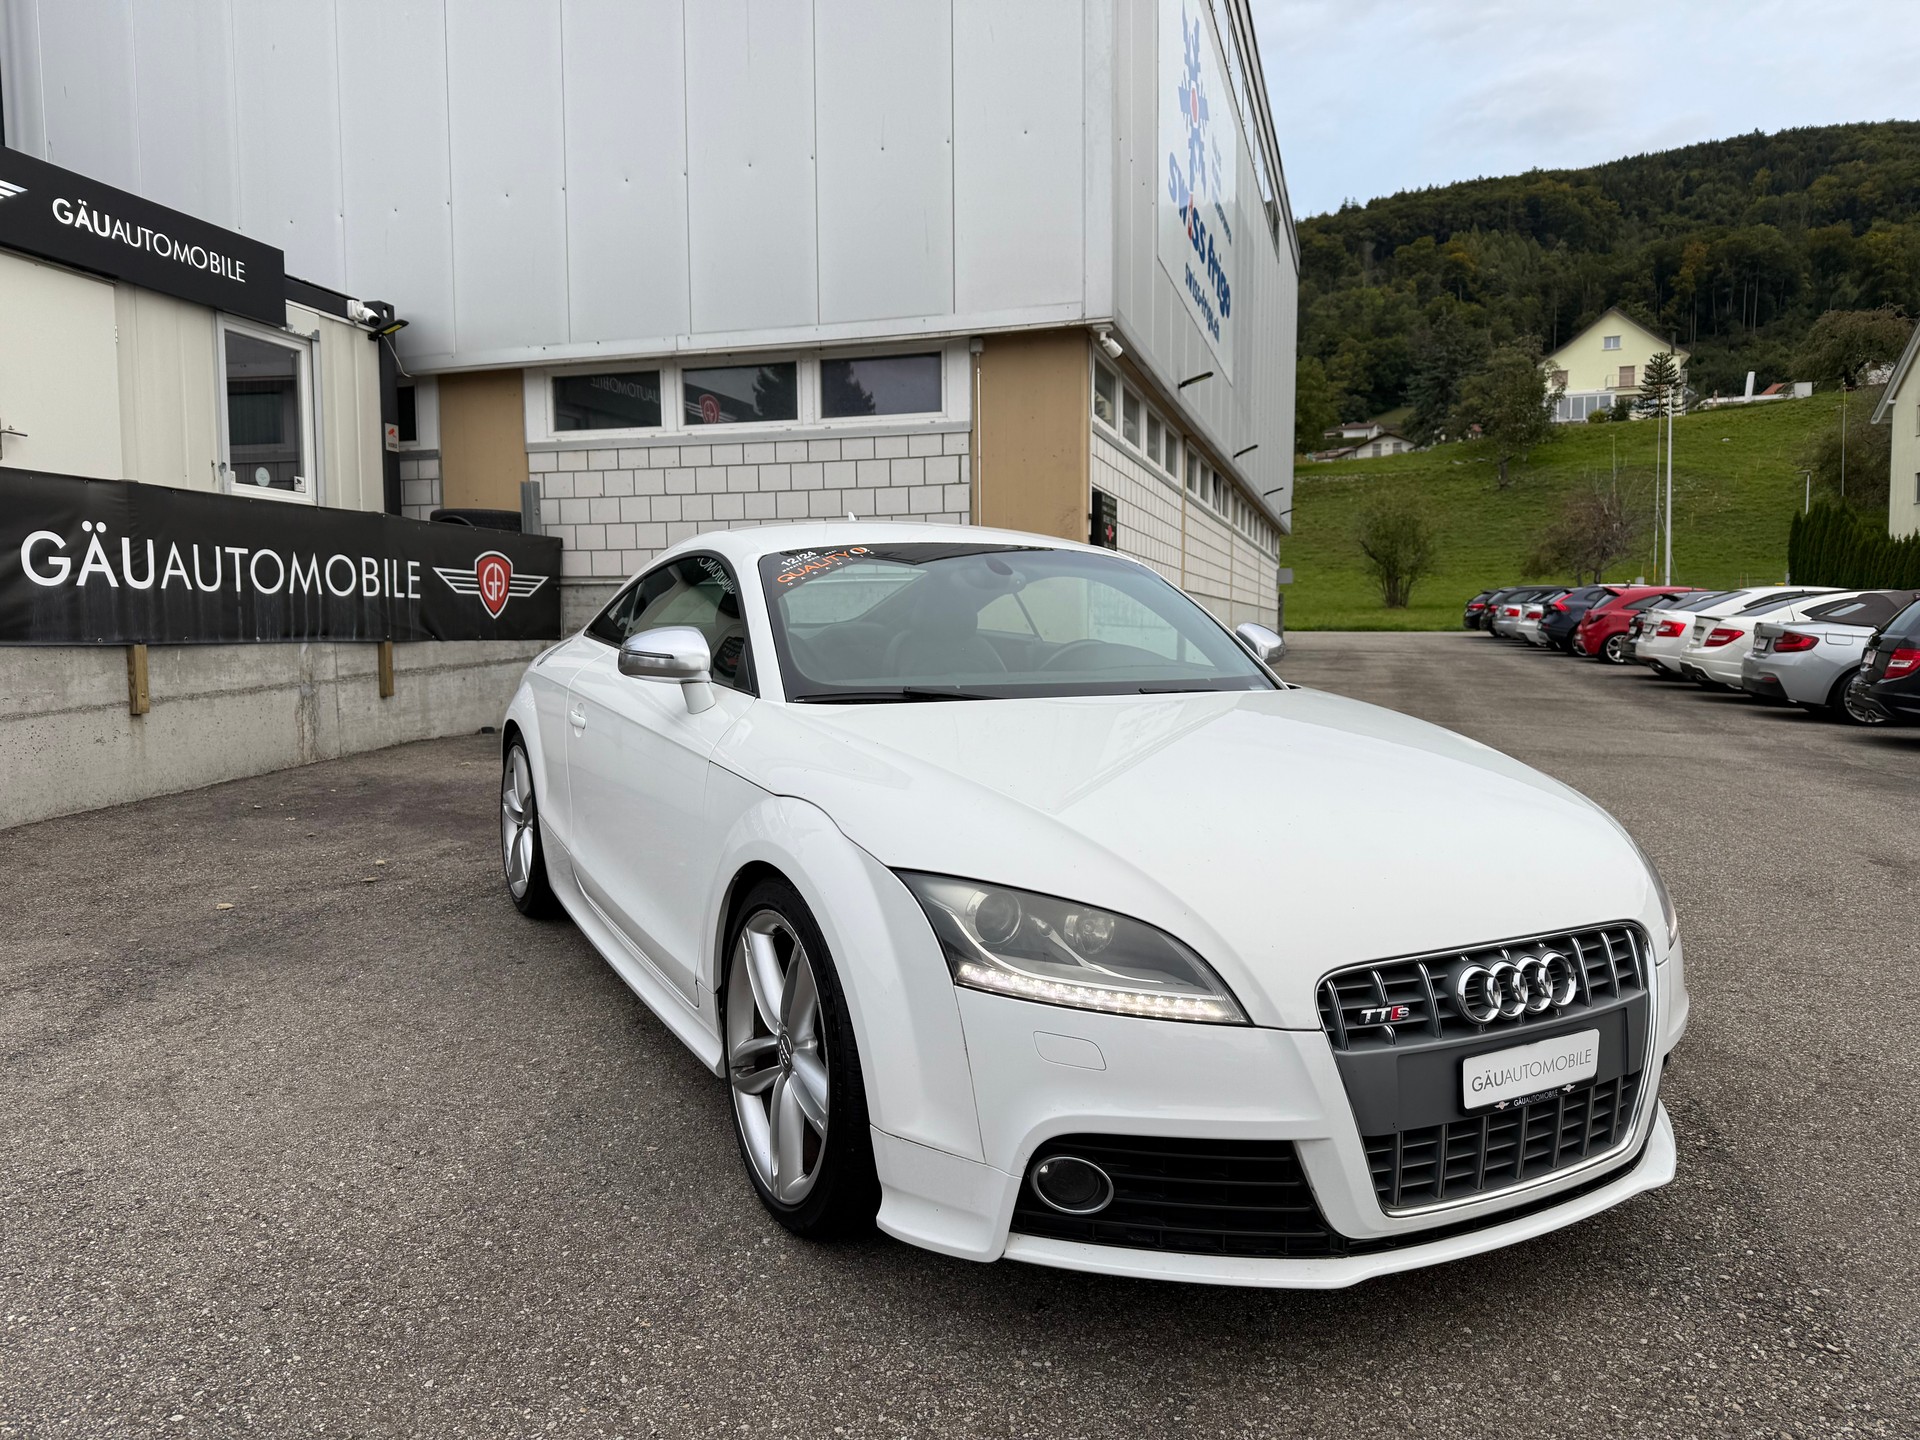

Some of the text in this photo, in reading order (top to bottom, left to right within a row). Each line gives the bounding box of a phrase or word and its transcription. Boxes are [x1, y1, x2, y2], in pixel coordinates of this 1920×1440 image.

[52, 198, 246, 283] GÄUAUTOMOBILE
[20, 520, 421, 599] GÄUAUTOMOBILE
[777, 551, 850, 583] QUALITY
[1361, 1006, 1410, 1024] TTS
[1471, 1048, 1592, 1092] GÄUAUTOMOBILE
